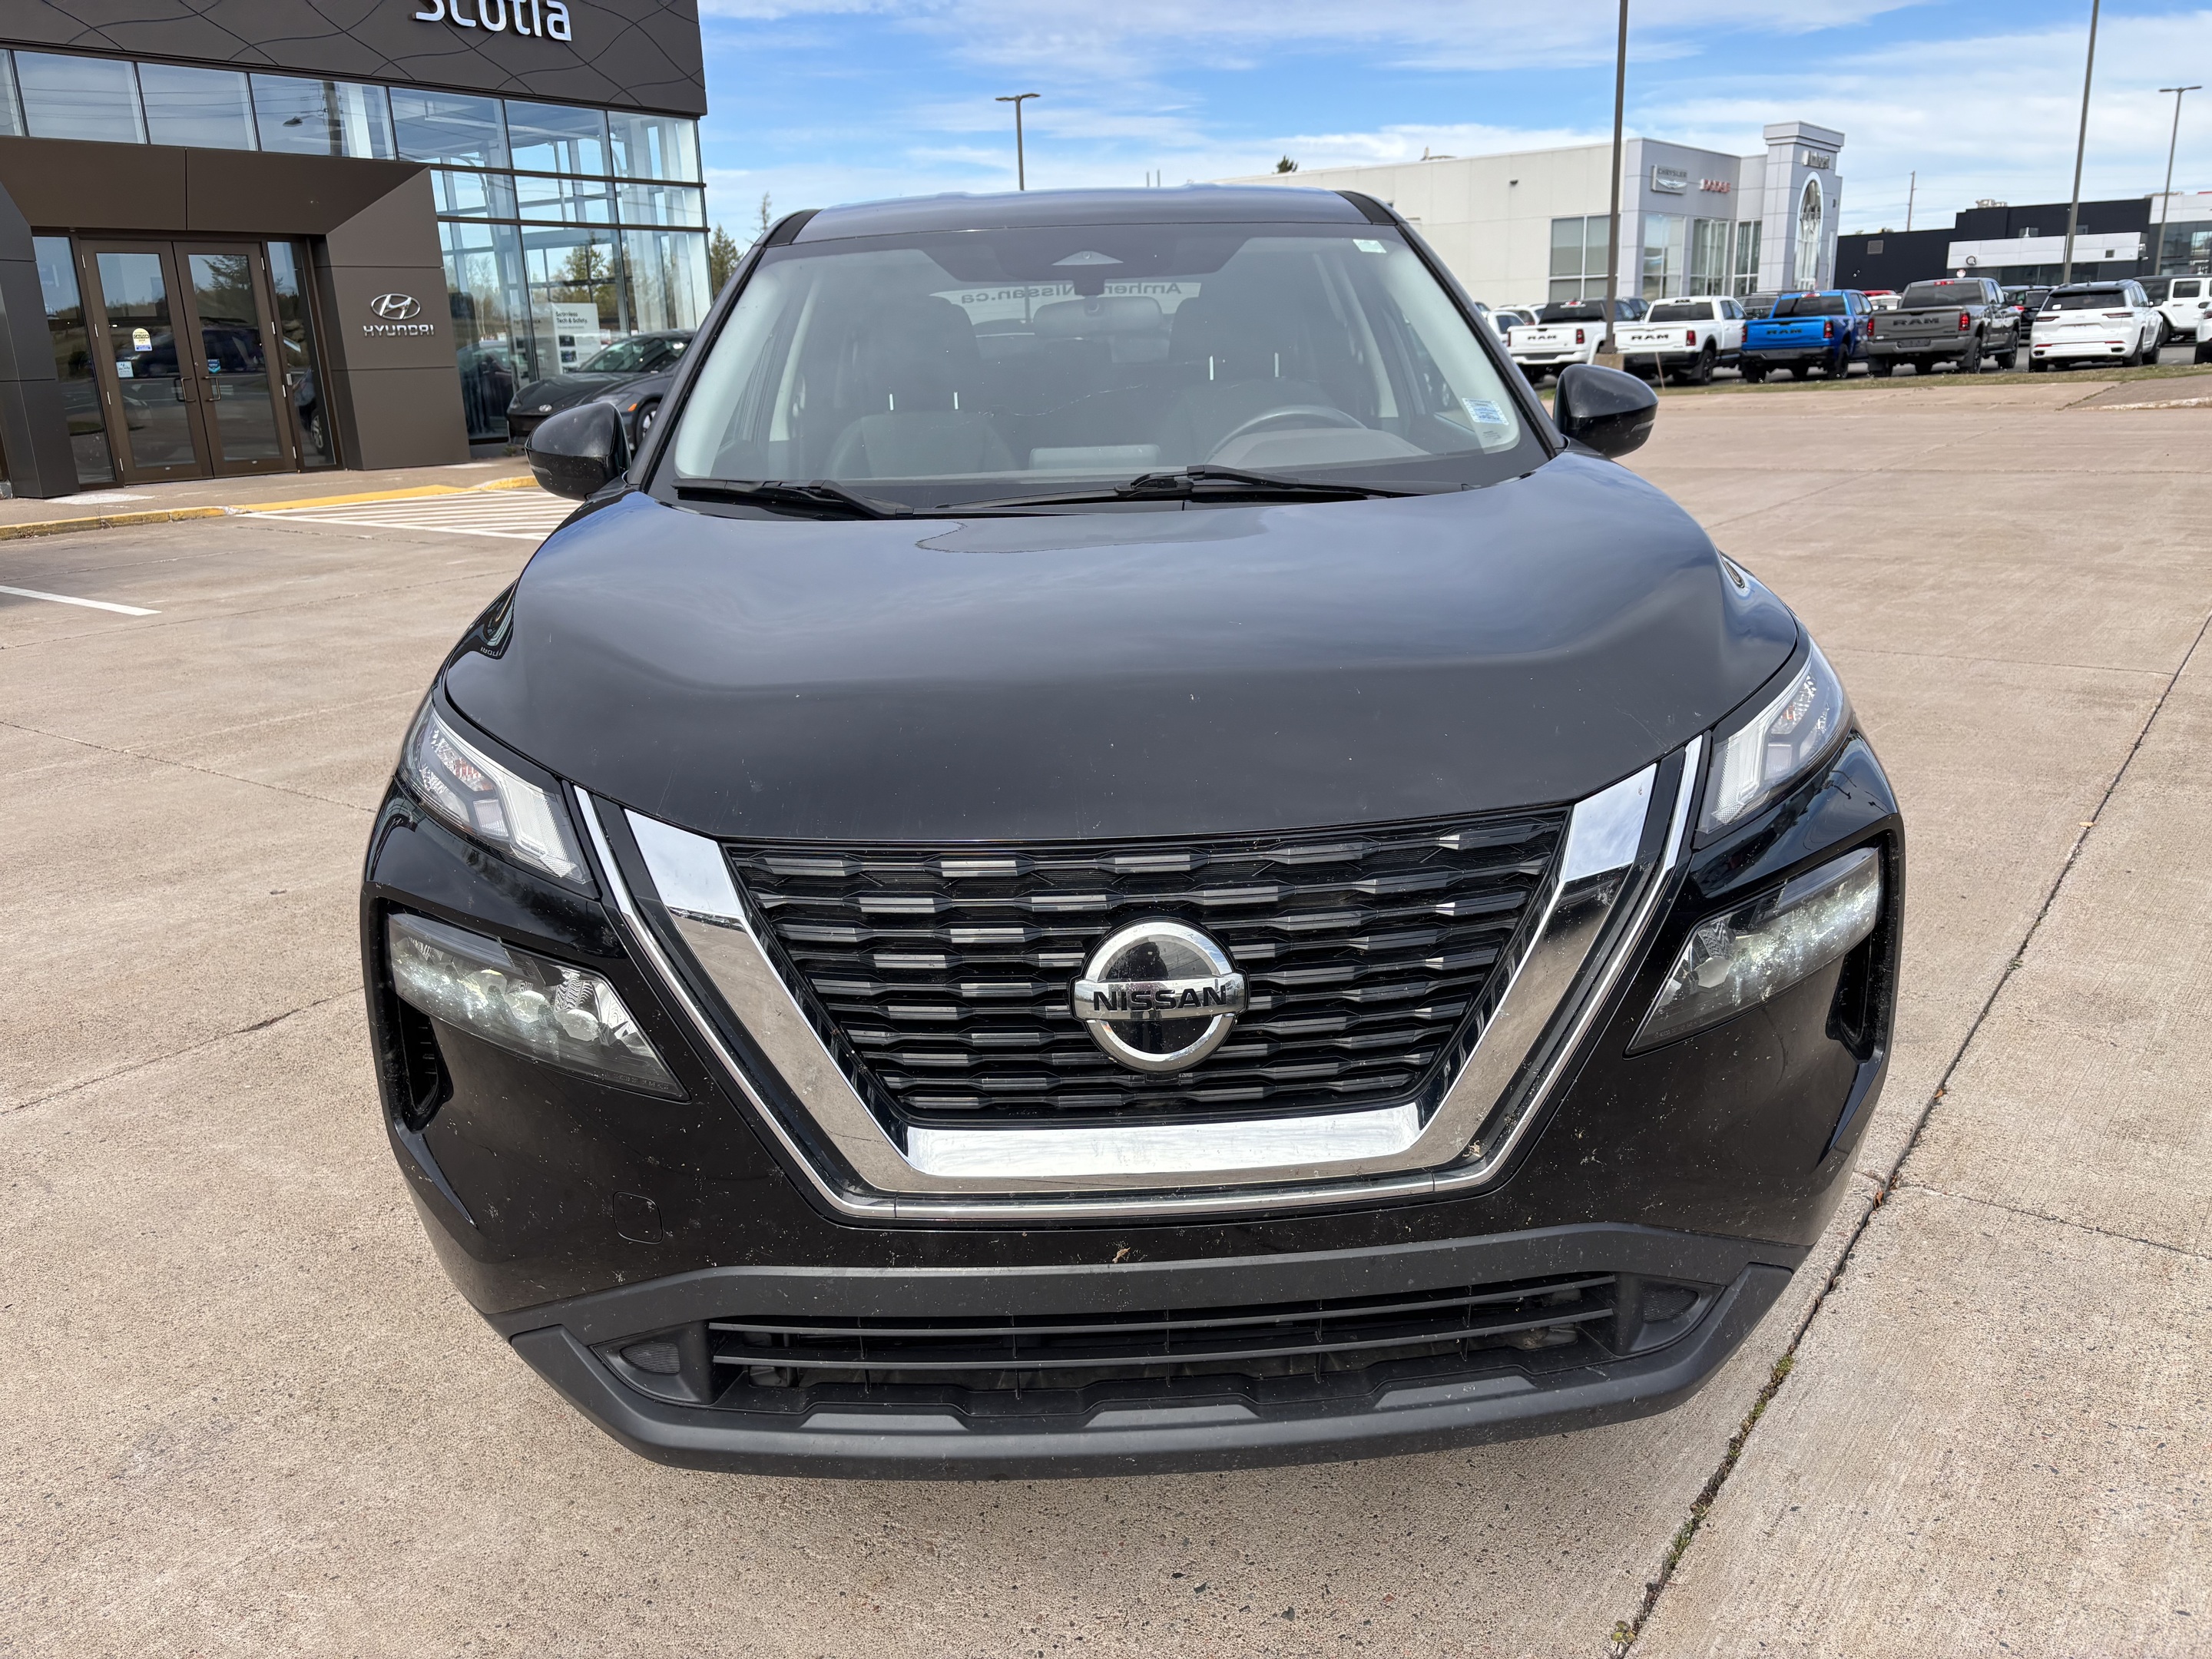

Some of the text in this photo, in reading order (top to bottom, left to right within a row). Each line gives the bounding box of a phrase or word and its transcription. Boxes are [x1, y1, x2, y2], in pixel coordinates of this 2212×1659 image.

[1892, 317, 1939, 326] RAM
[363, 324, 435, 336] HYUNDAI
[1094, 984, 1227, 1012] NISSAN
